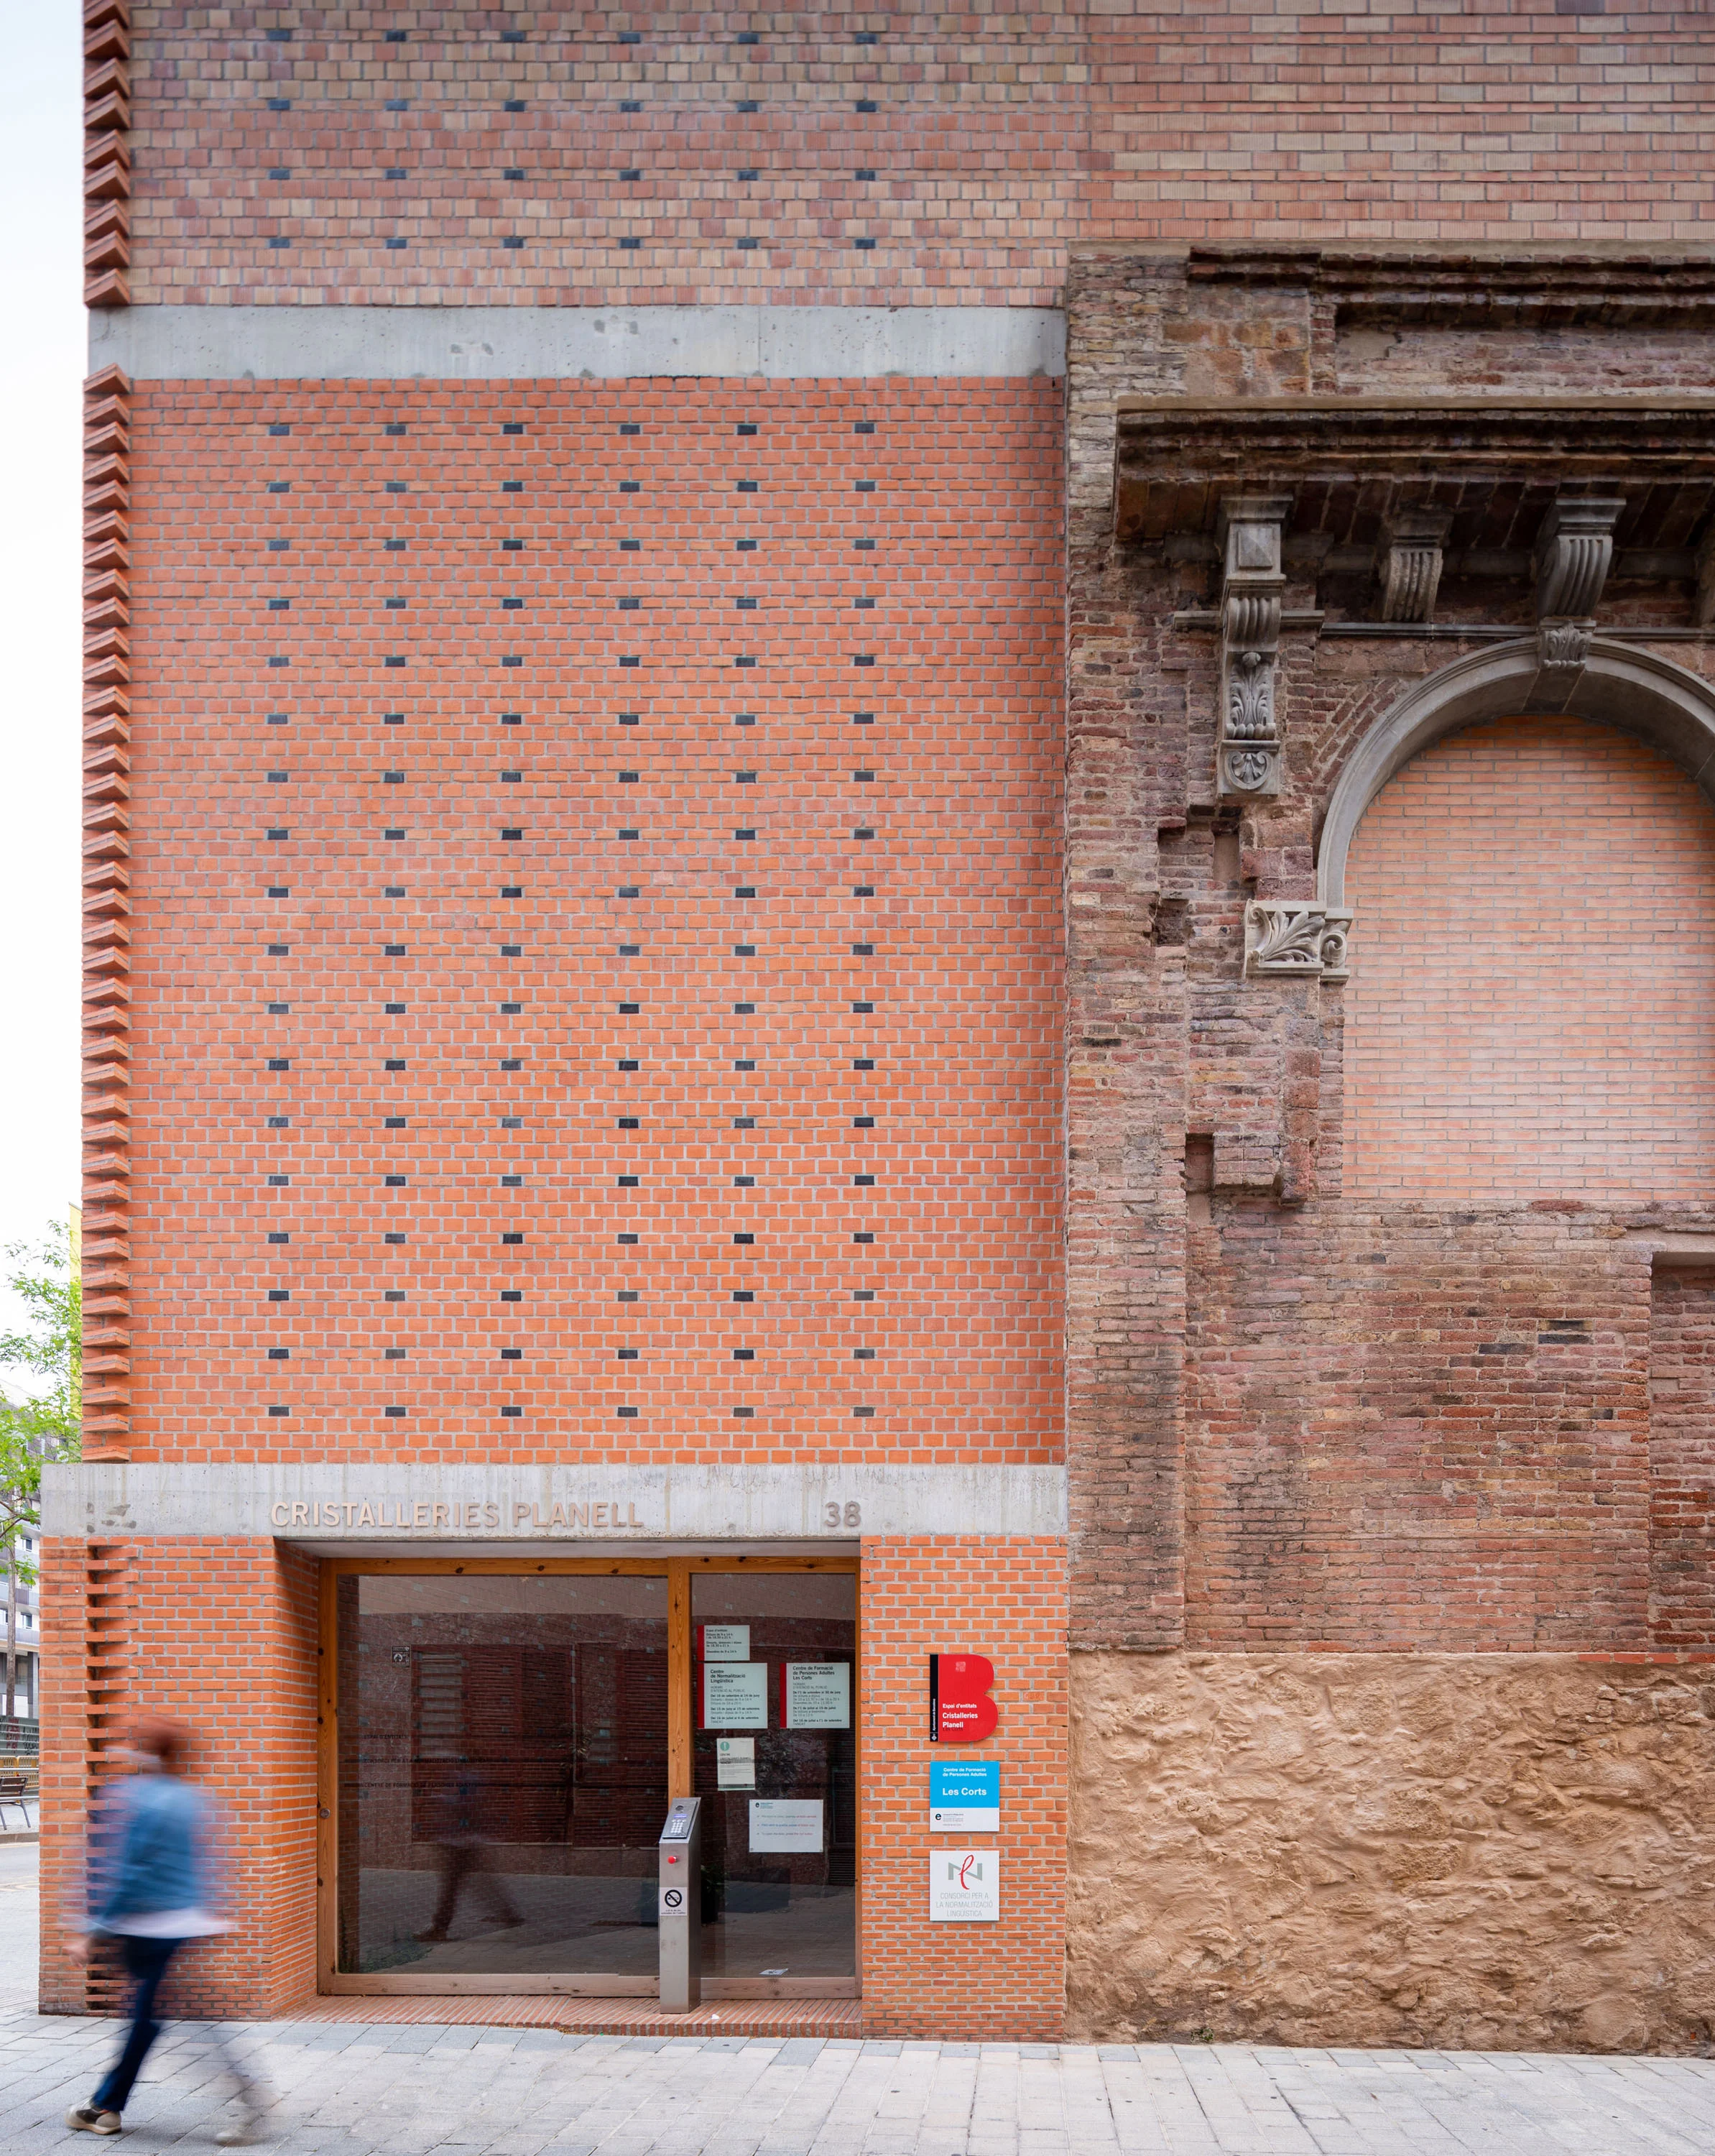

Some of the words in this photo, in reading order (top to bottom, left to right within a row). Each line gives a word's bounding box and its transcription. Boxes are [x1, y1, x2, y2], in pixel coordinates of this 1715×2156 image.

[271, 1501, 499, 1527] CRISTALLERIES
[513, 1501, 644, 1527] PLANELL
[824, 1501, 861, 1527] 38
